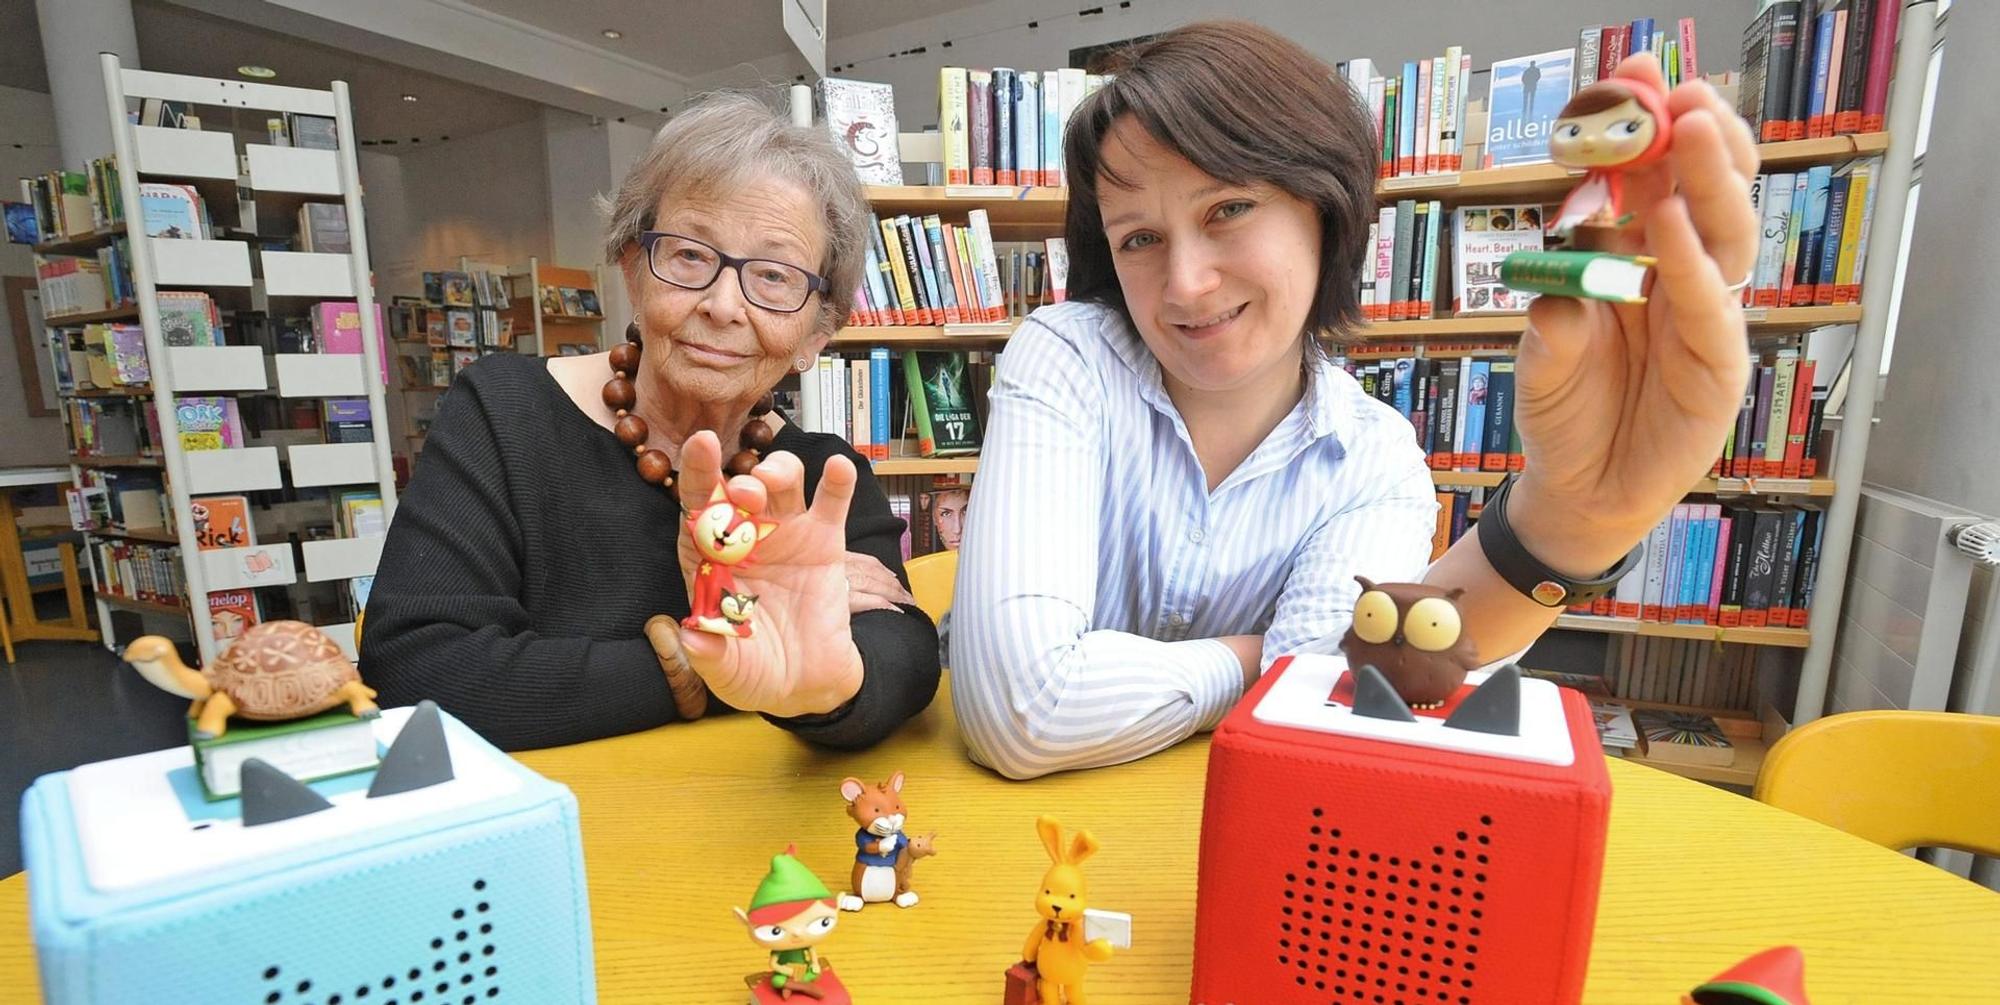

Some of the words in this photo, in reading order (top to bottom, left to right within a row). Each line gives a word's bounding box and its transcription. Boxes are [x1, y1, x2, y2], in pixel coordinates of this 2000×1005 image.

[1765, 209, 1790, 244] Seele
[1376, 235, 1392, 279] SIMPEL
[1382, 372, 1393, 397] Camp
[1773, 374, 1787, 414] SMART
[945, 421, 965, 440] 17
[210, 593, 247, 606] nelop
